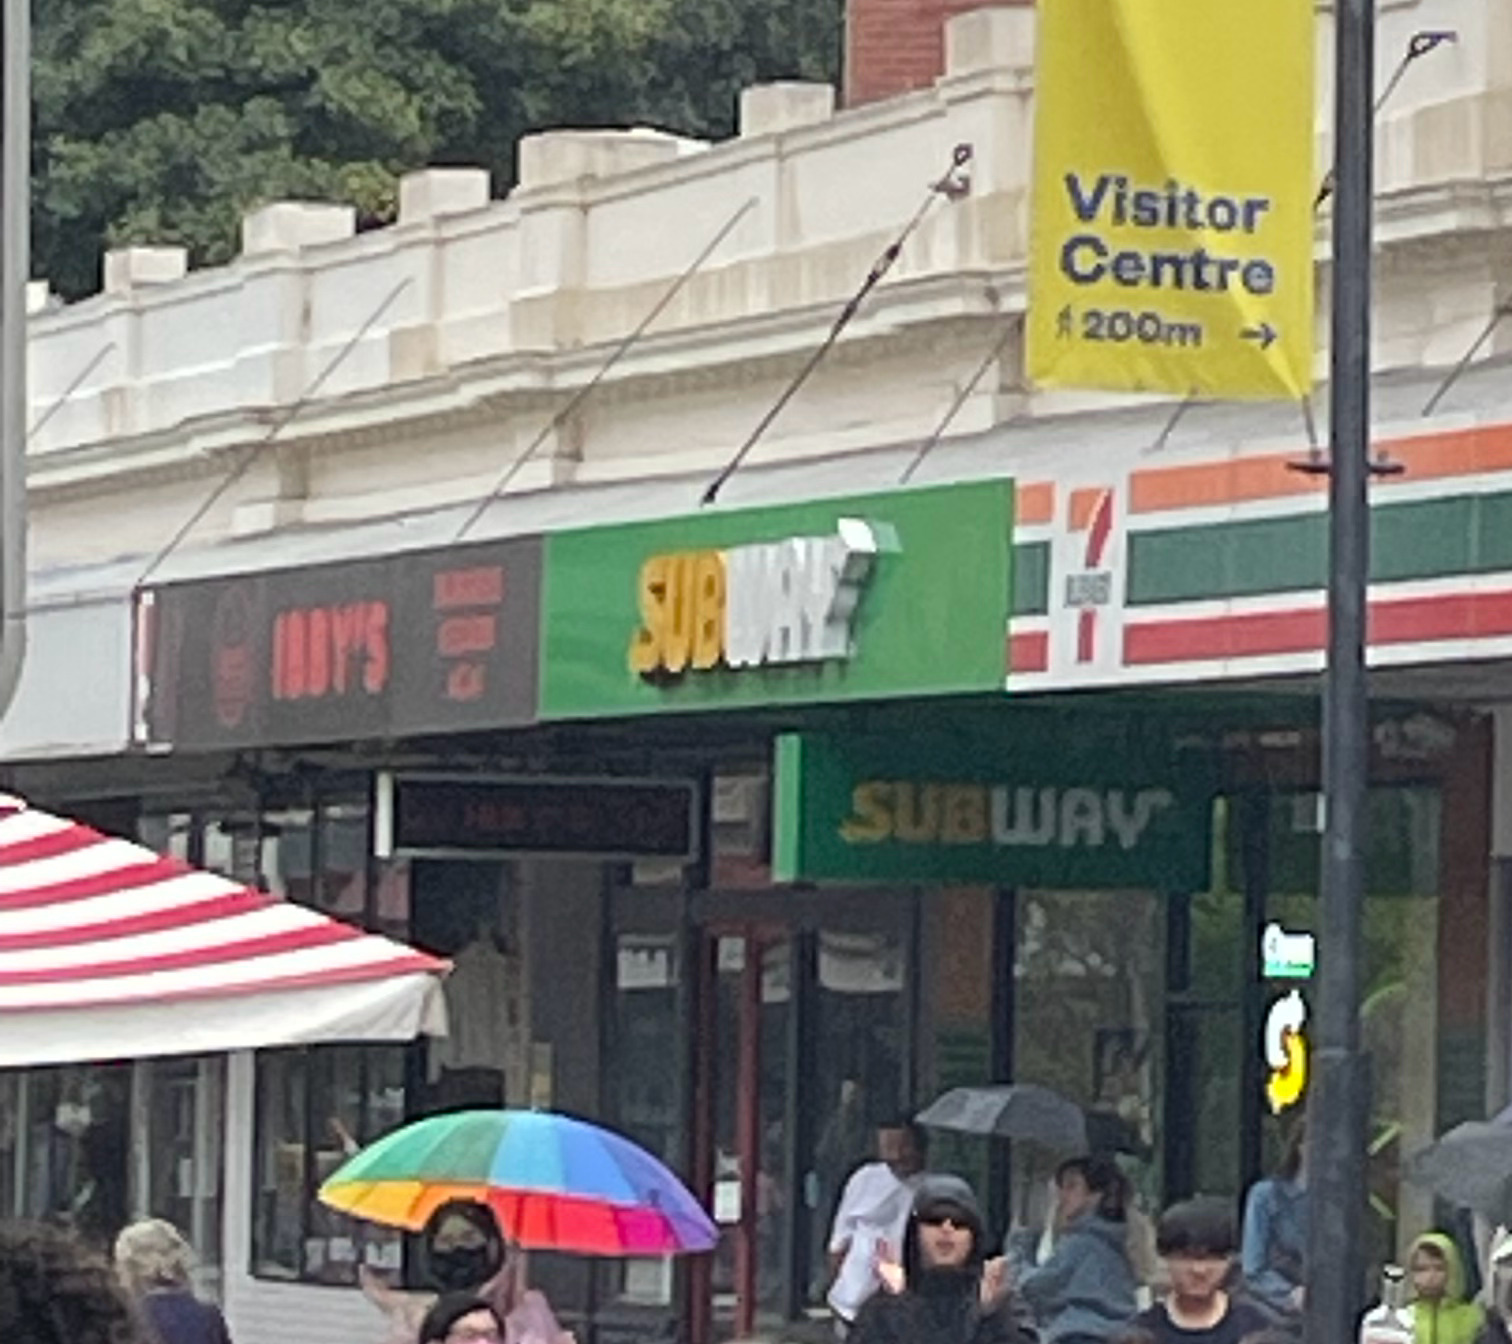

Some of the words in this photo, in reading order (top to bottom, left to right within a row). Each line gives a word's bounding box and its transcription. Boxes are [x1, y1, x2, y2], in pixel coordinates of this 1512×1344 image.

[1064, 172, 1270, 234] Visitor
[1060, 235, 1275, 295] Centre
[1082, 308, 1203, 347] 200m
[837, 779, 1174, 850] SUBWAY
